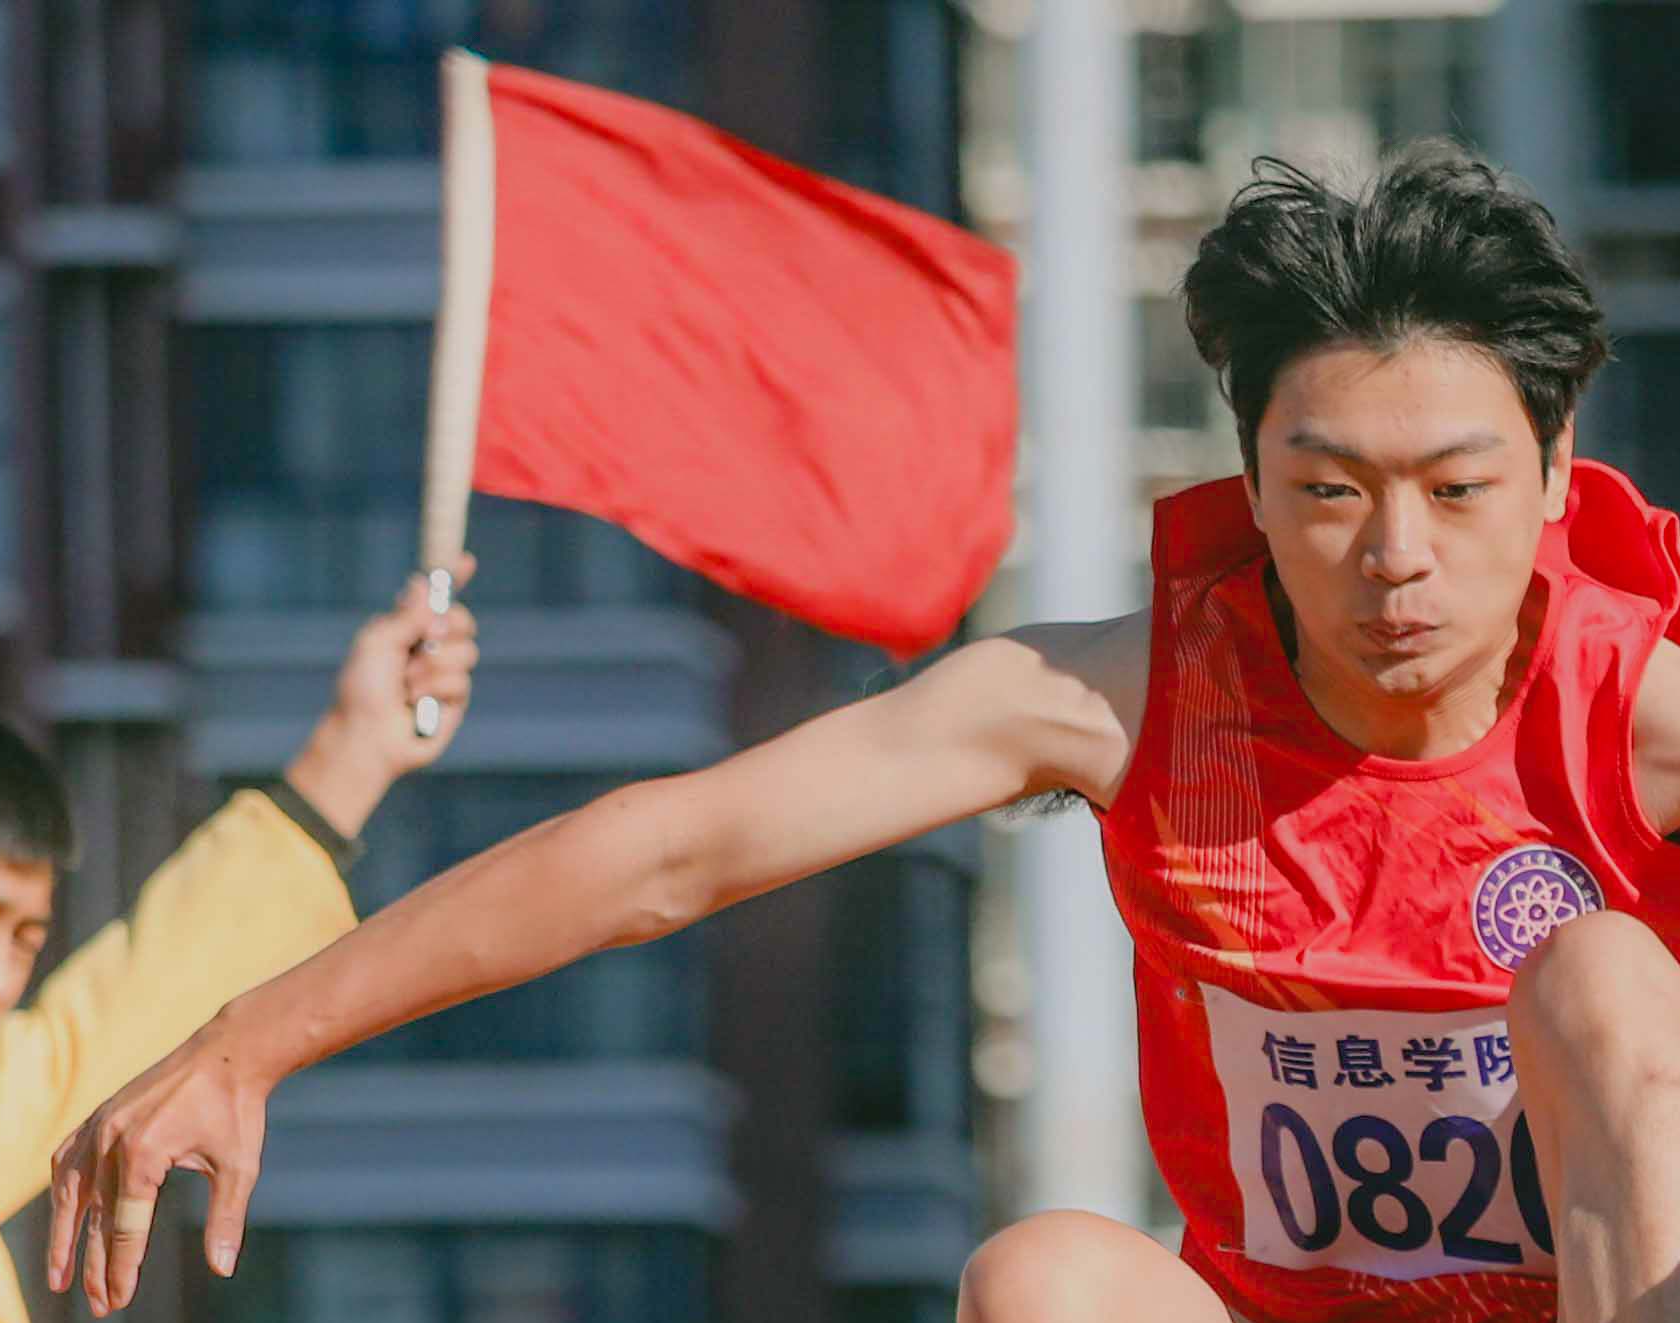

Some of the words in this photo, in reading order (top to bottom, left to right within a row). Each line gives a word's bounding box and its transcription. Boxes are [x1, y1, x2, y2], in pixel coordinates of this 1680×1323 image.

[1262, 1031, 1517, 1092] 信息学院
[1262, 1103, 1555, 1264] 082
